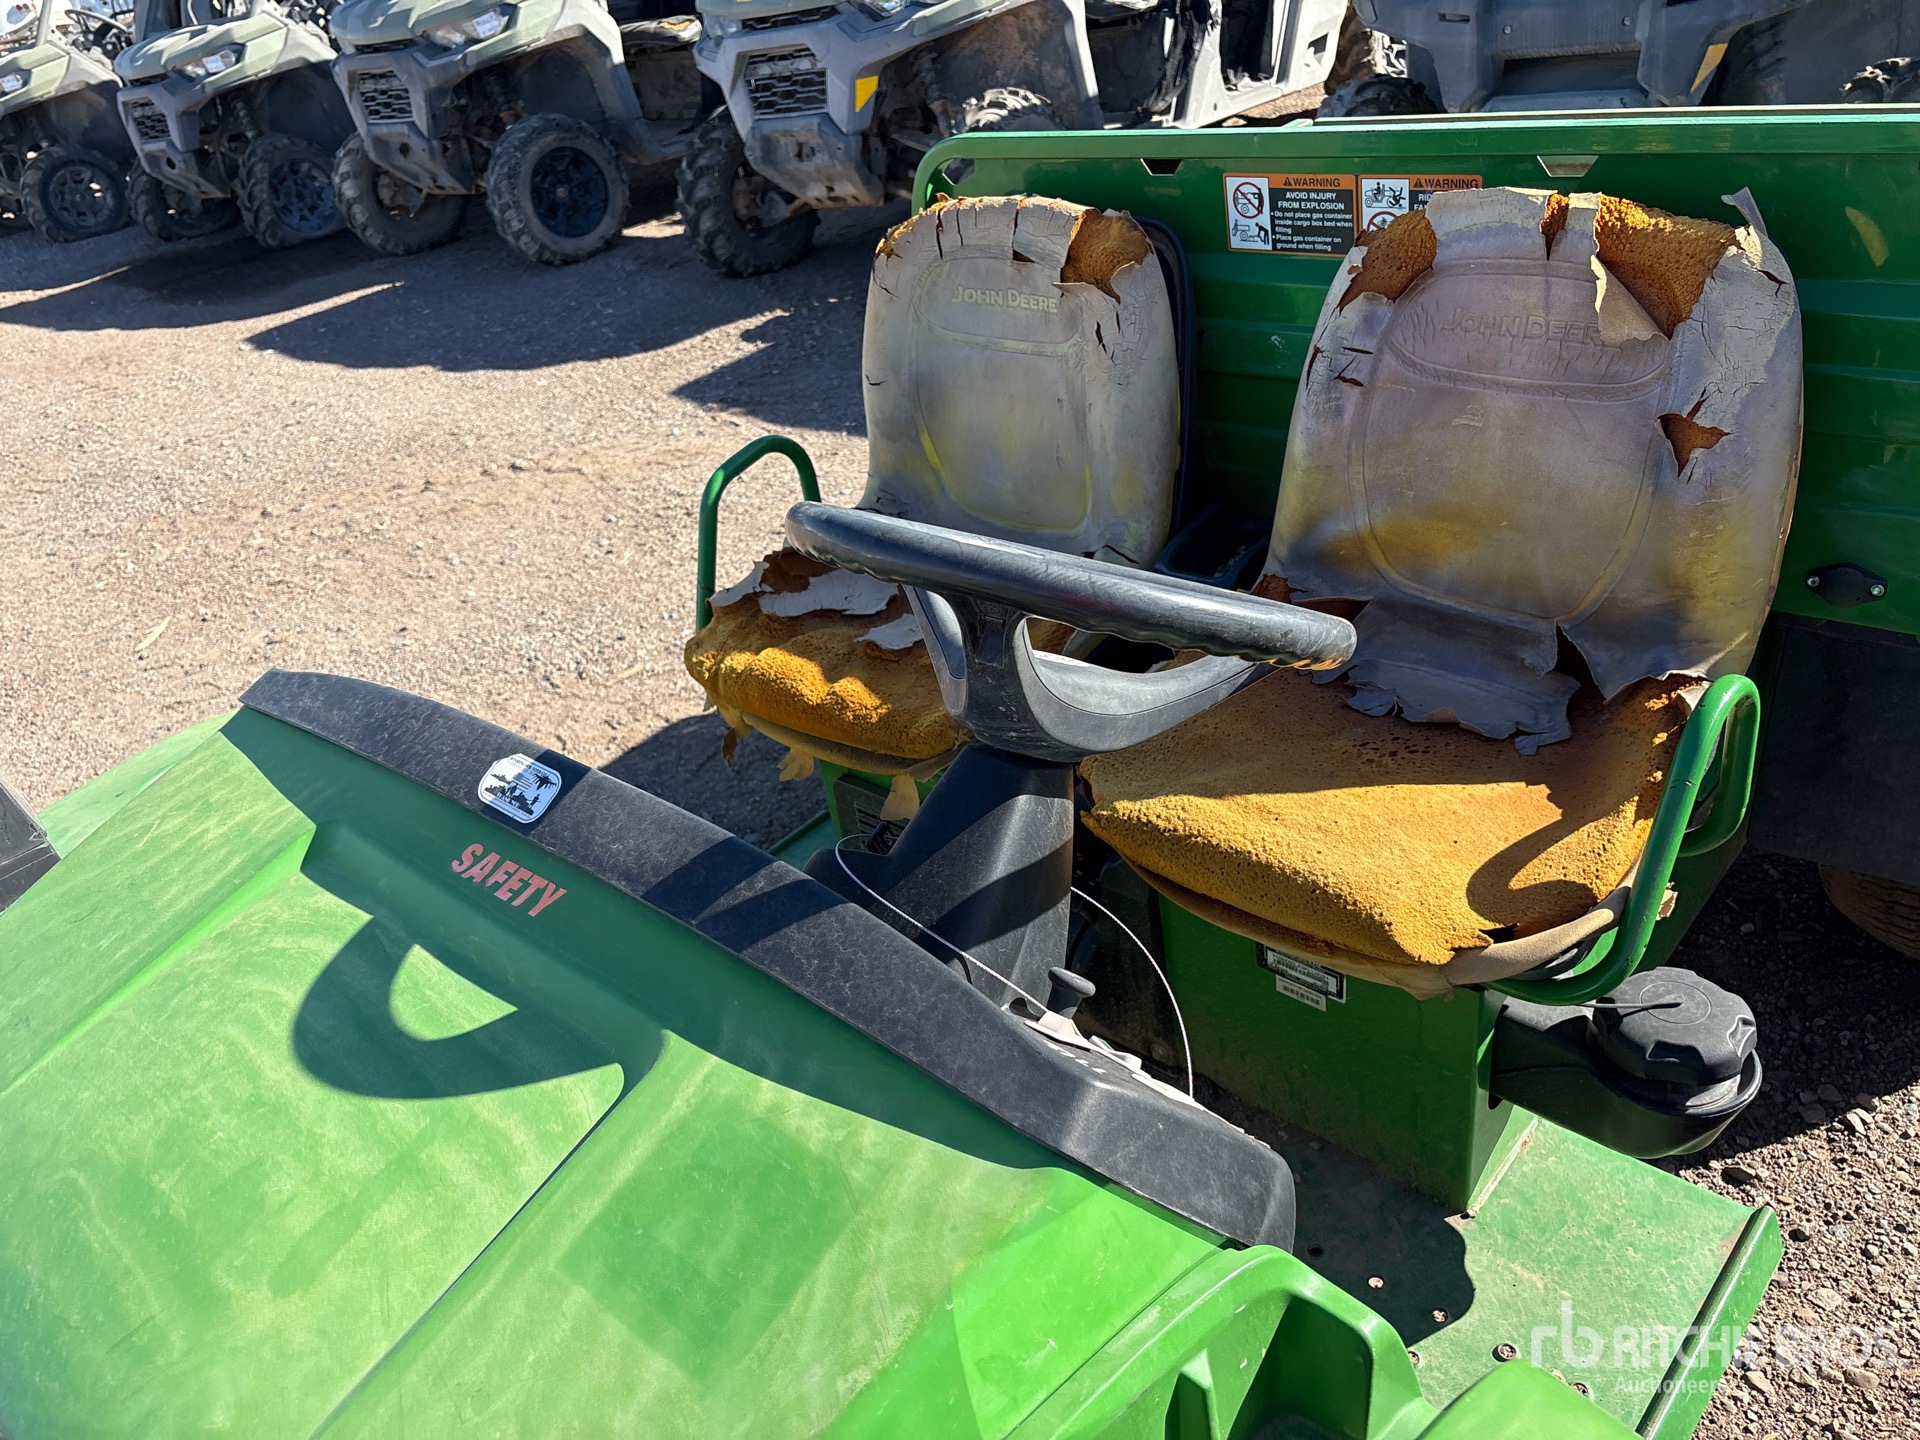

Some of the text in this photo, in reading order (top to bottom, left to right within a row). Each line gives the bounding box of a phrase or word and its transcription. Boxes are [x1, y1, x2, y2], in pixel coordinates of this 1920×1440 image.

[1292, 177, 1341, 188] WARNING
[1424, 178, 1479, 189] WARNING
[1285, 191, 1337, 200] AVOID INJURY
[1277, 200, 1345, 210] FROM EXPLOSION
[1295, 211, 1311, 219] place
[1274, 218, 1293, 226] inside
[1275, 226, 1292, 234] filling
[1304, 235, 1332, 243] container
[1314, 243, 1332, 251] filling
[951, 286, 1058, 313] JOHN DEERE
[1441, 308, 1605, 346] JOHN DEER
[451, 843, 568, 918] SAFETY
